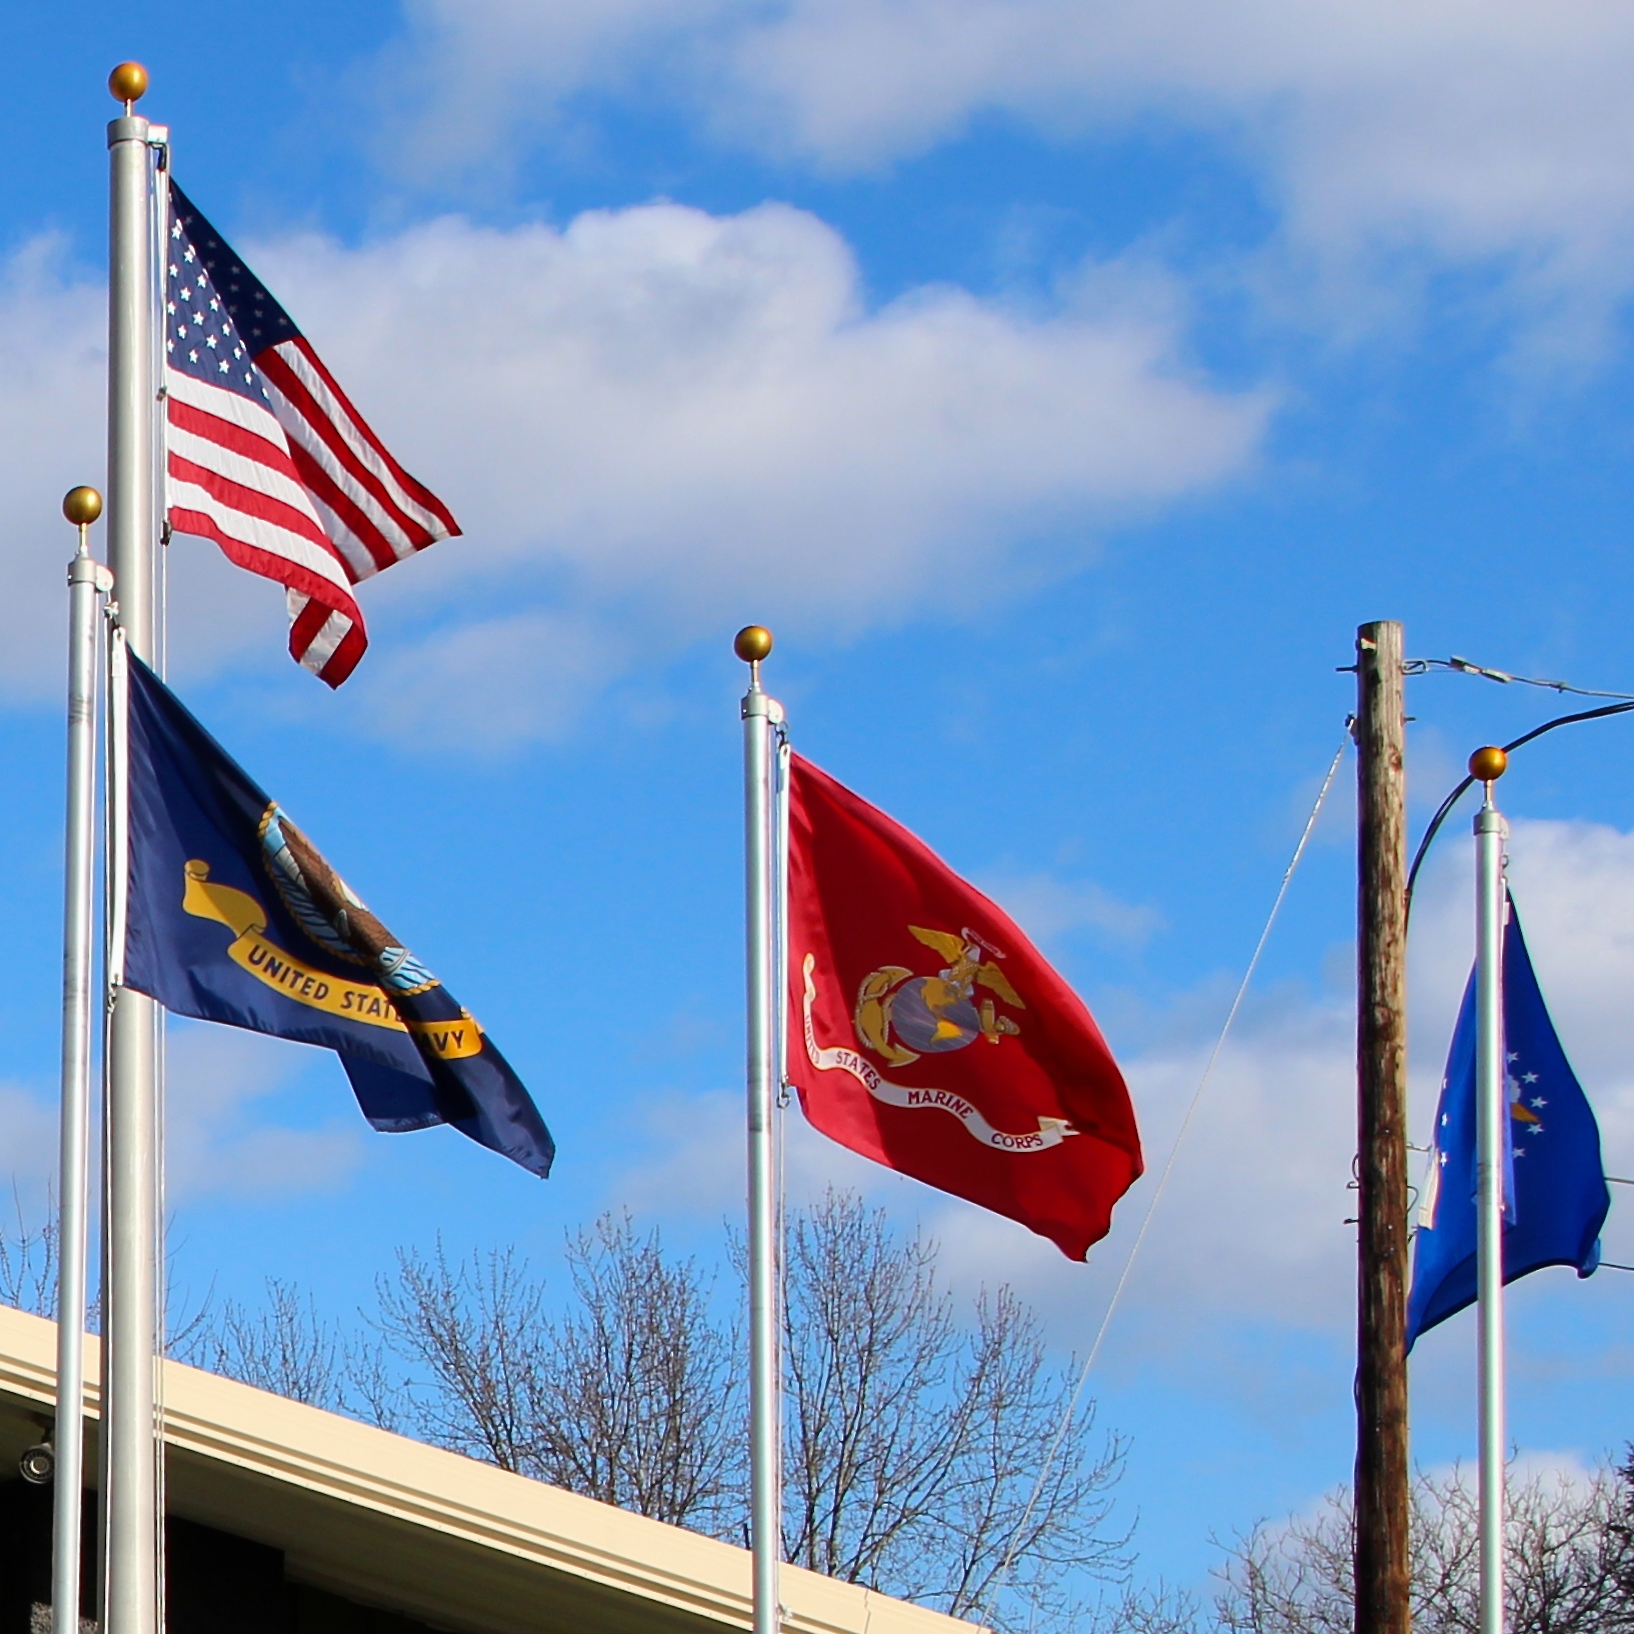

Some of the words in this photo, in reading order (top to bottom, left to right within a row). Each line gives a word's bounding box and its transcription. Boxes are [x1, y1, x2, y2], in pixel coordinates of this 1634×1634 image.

[247, 945, 329, 1001] UNITED
[340, 990, 402, 1021] STAT
[420, 1030, 464, 1051] AVY
[805, 1014, 820, 1064] UNITED
[836, 1051, 881, 1090] STATES
[908, 1091, 973, 1119] MARINE
[991, 1132, 1043, 1149] CORPS
